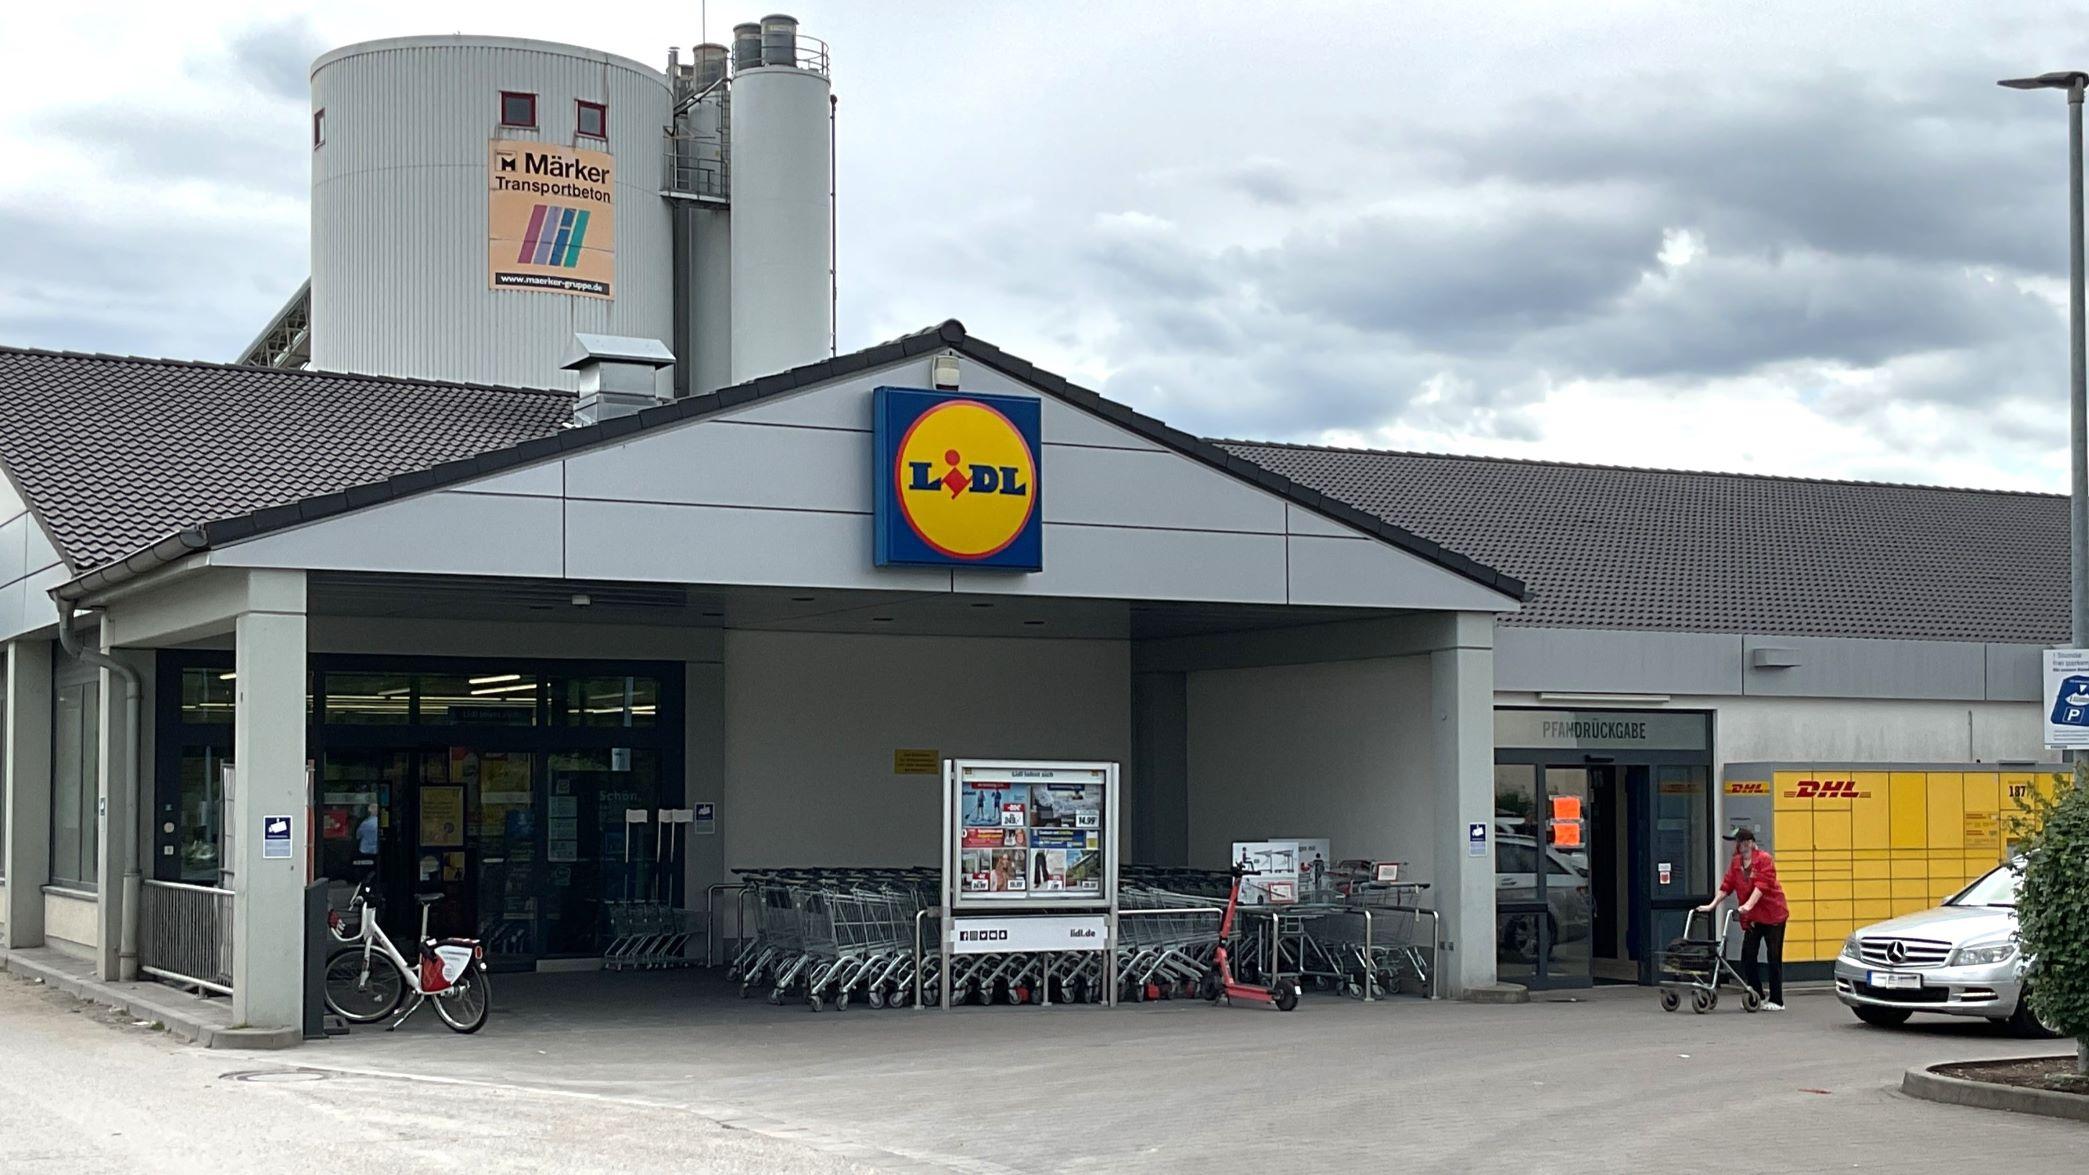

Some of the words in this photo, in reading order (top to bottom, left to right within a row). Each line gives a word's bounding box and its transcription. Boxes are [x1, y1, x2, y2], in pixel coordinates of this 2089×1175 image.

[525, 152, 610, 184] Märker
[495, 176, 611, 203] Transportbeton
[500, 274, 603, 293] www.maerker-gruppe.de
[908, 449, 1027, 500] LIDL
[2067, 709, 2080, 721] P
[1542, 718, 1647, 740] PFANDRÜCKGABE
[1731, 783, 1764, 794] DHL
[1796, 780, 1860, 798] DHL
[2009, 785, 2026, 797] 187
[1070, 928, 1096, 938] lidl.de
